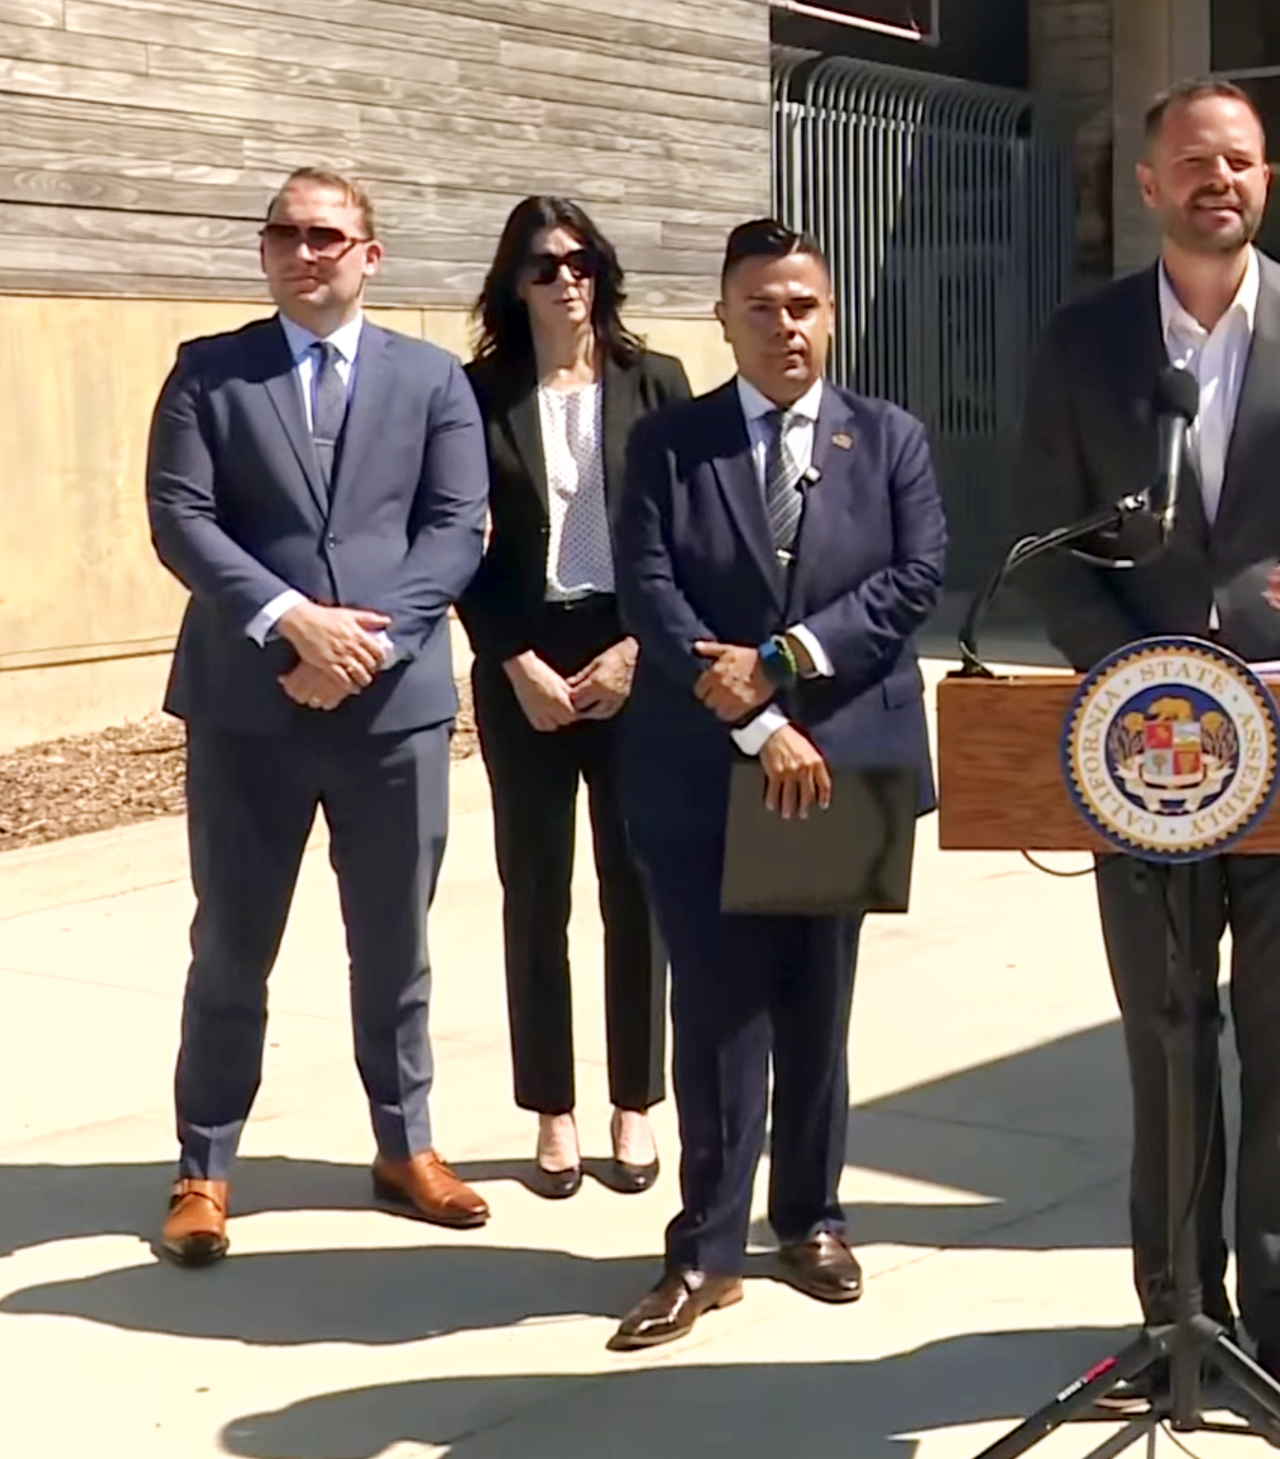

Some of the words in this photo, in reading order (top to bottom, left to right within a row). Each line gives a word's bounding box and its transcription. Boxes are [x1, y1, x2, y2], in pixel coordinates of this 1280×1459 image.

[1082, 689, 1158, 836] CALIFORNIA
[1139, 660, 1229, 695] STATE
[1190, 711, 1261, 838] ASSEMBLY
